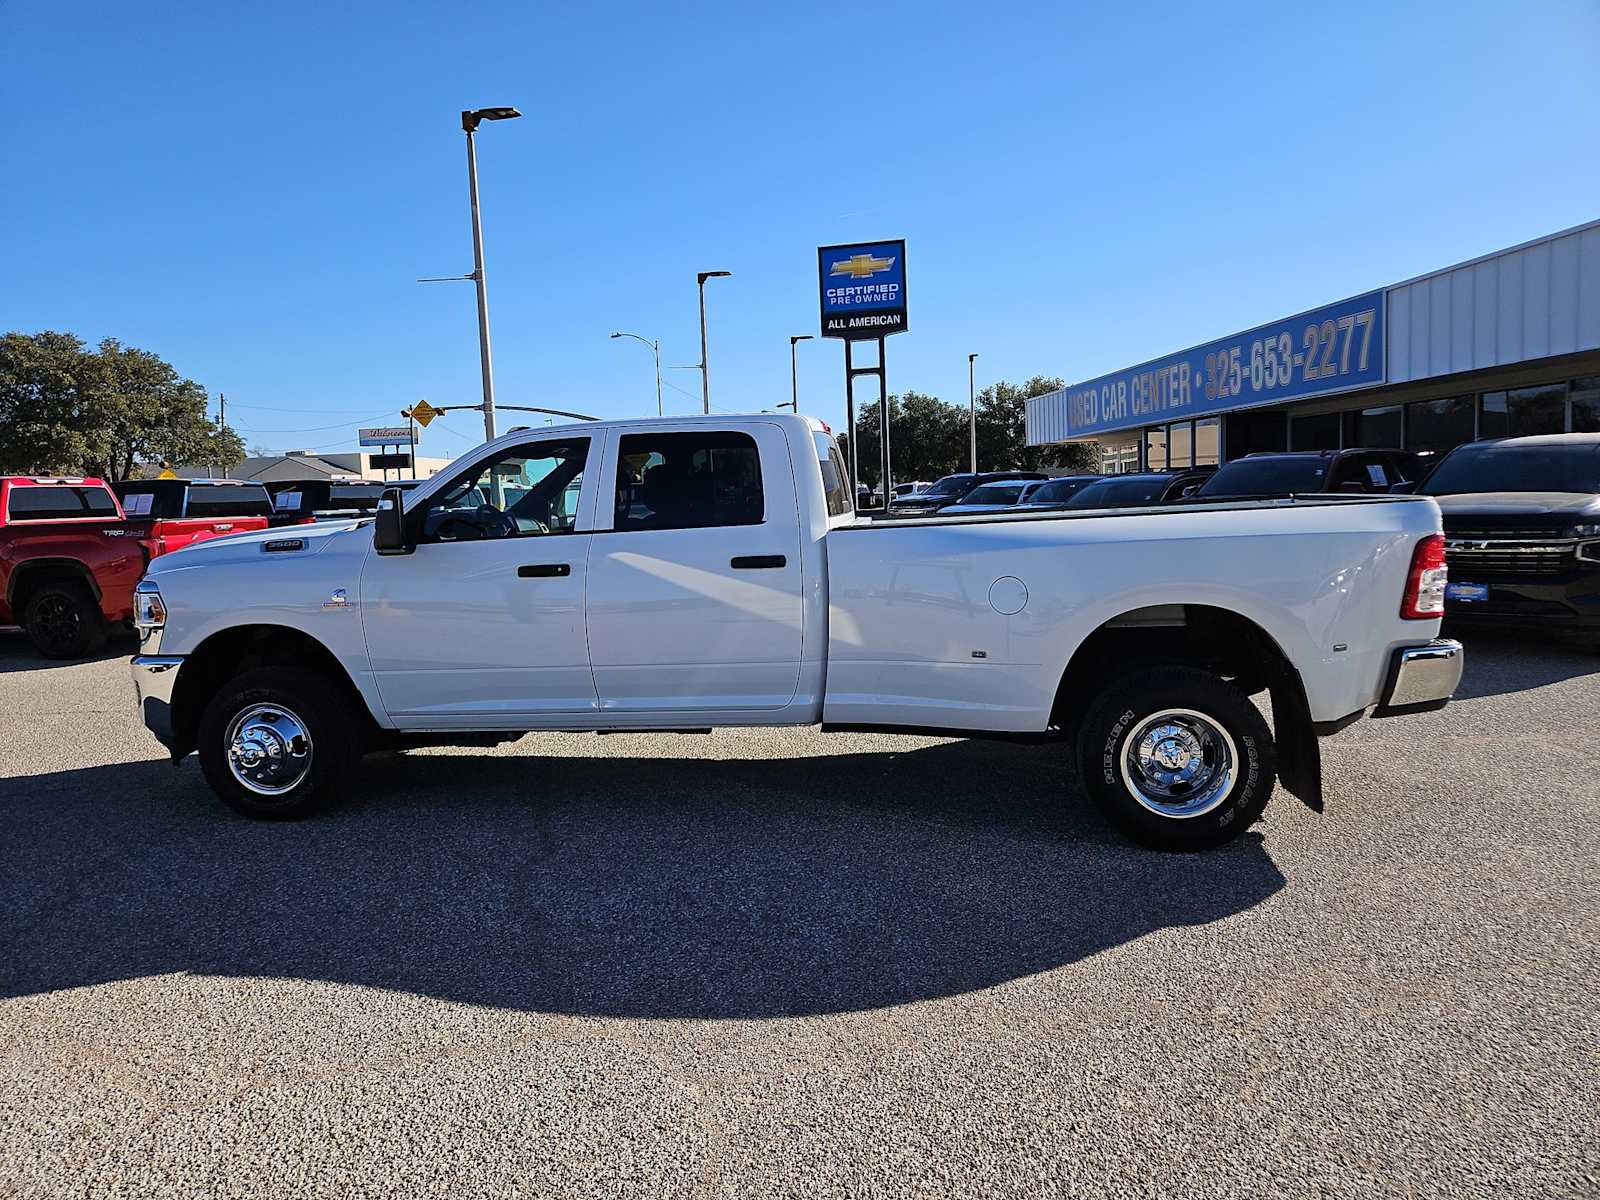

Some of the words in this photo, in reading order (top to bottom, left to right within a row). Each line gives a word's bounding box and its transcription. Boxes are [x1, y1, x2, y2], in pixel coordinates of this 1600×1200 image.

[826, 283, 899, 297] CERTIFIED
[830, 292, 896, 305] PRE-OWNED
[828, 319, 846, 329] ALL
[849, 314, 901, 328] AMERICAN
[1070, 389, 1099, 428] USED
[1101, 380, 1127, 422] CAR
[1131, 361, 1192, 417] CENTER
[1206, 308, 1376, 400] 325-653-2277
[102, 529, 124, 537] TRD
[1103, 709, 1136, 785] NEXEN
